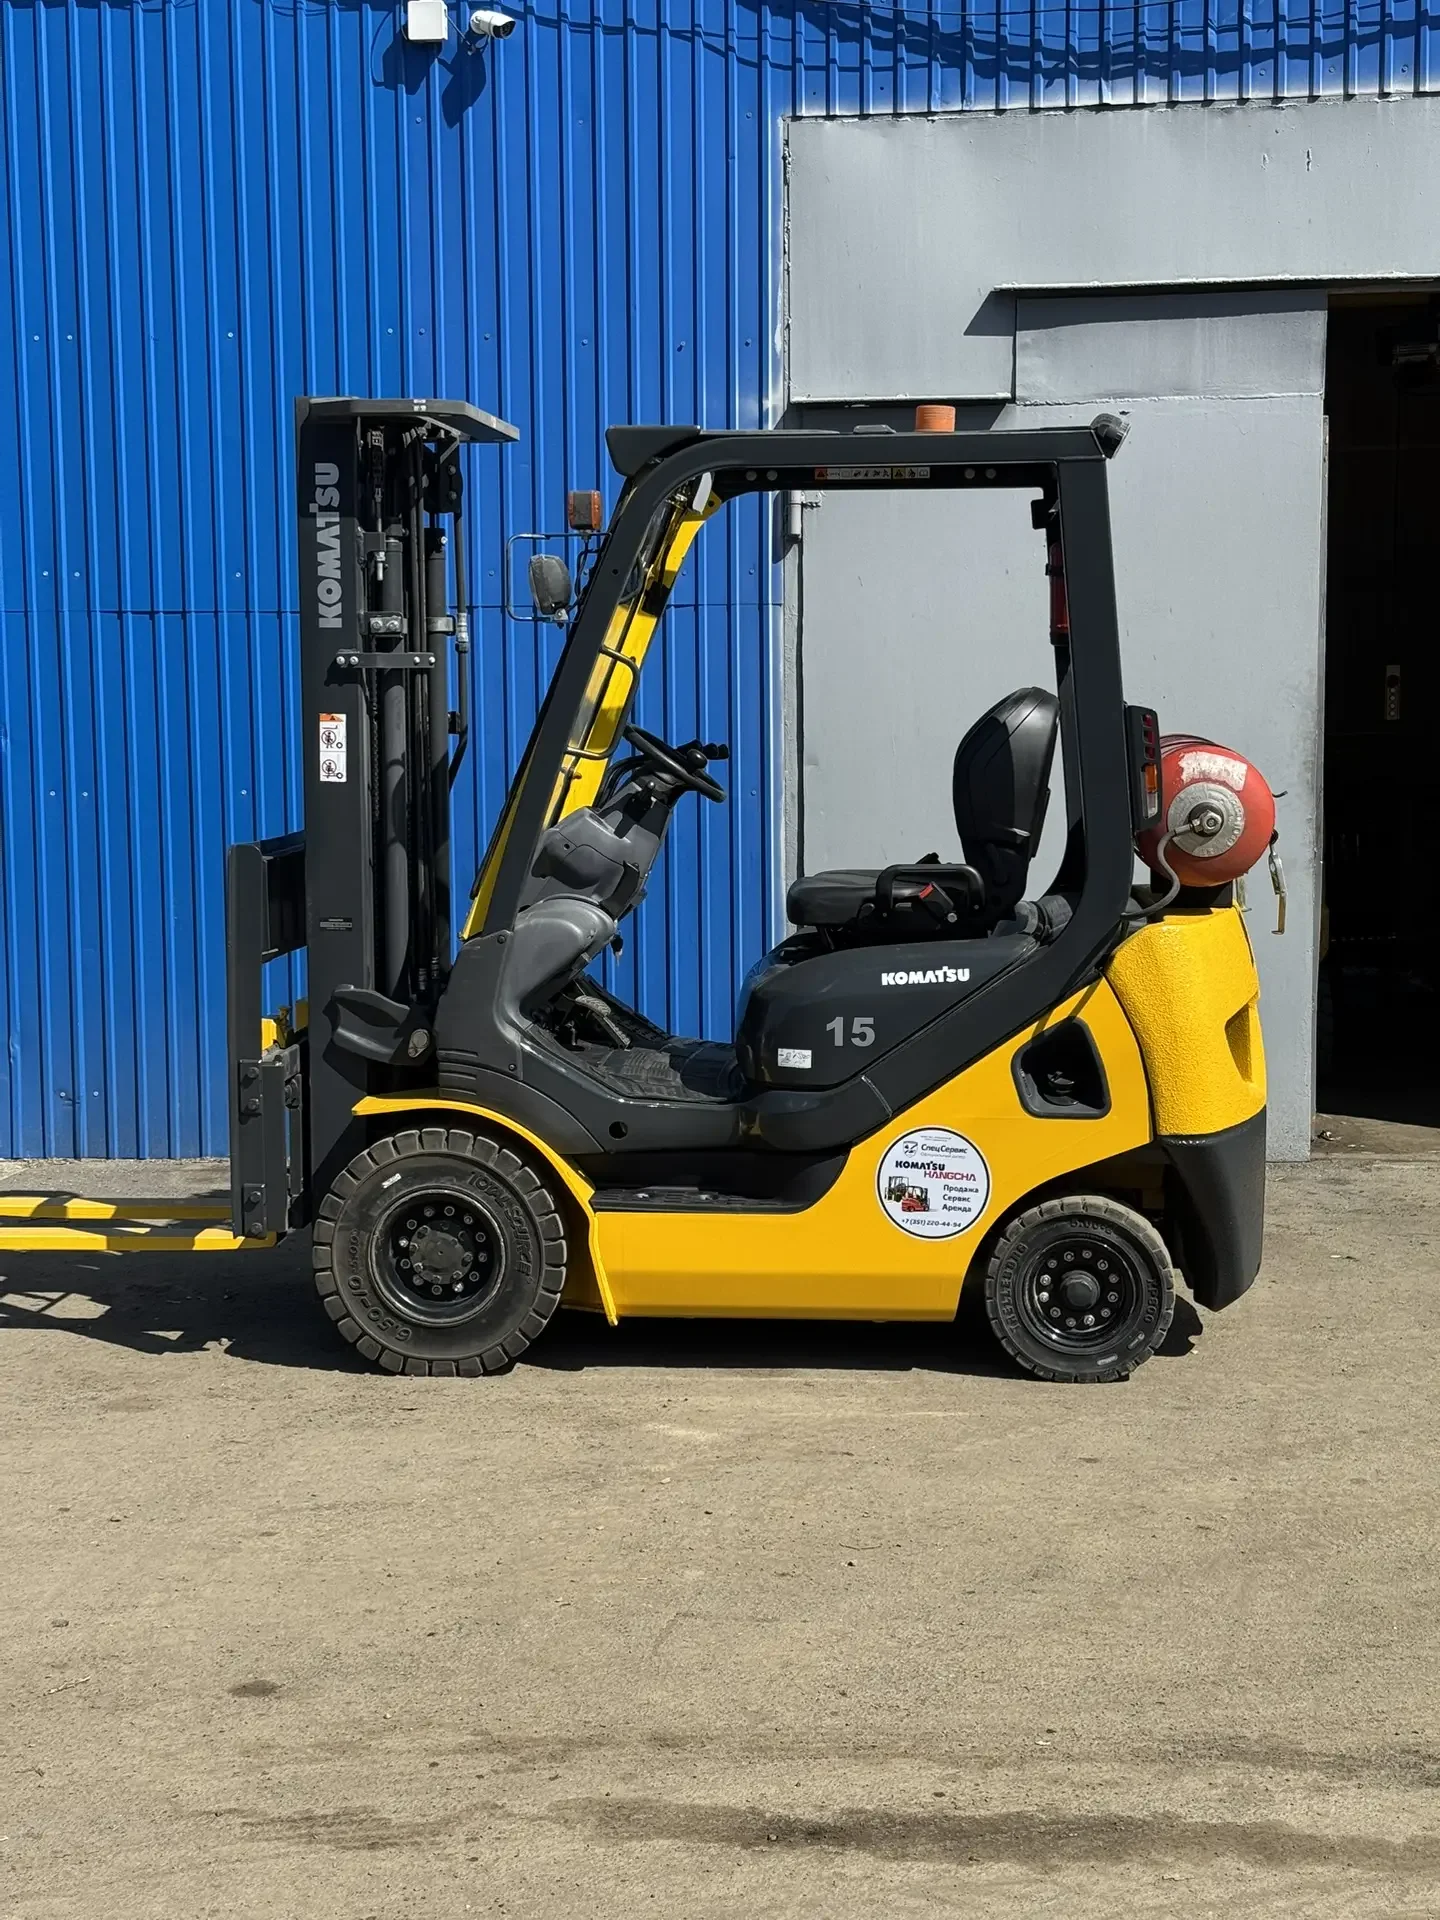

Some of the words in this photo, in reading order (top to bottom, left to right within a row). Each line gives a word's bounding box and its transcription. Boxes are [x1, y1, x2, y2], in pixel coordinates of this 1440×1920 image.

[309, 462, 342, 628] KOMATSU
[881, 966, 970, 986] KOMATSU
[826, 1016, 876, 1047] 15
[921, 1144, 967, 1154] СпецСервис
[895, 1161, 945, 1171] KOMATSU
[924, 1171, 976, 1181] HANGCHA
[943, 1184, 979, 1194] Продажа
[942, 1194, 971, 1203] Сервис
[942, 1203, 972, 1212] Аренда
